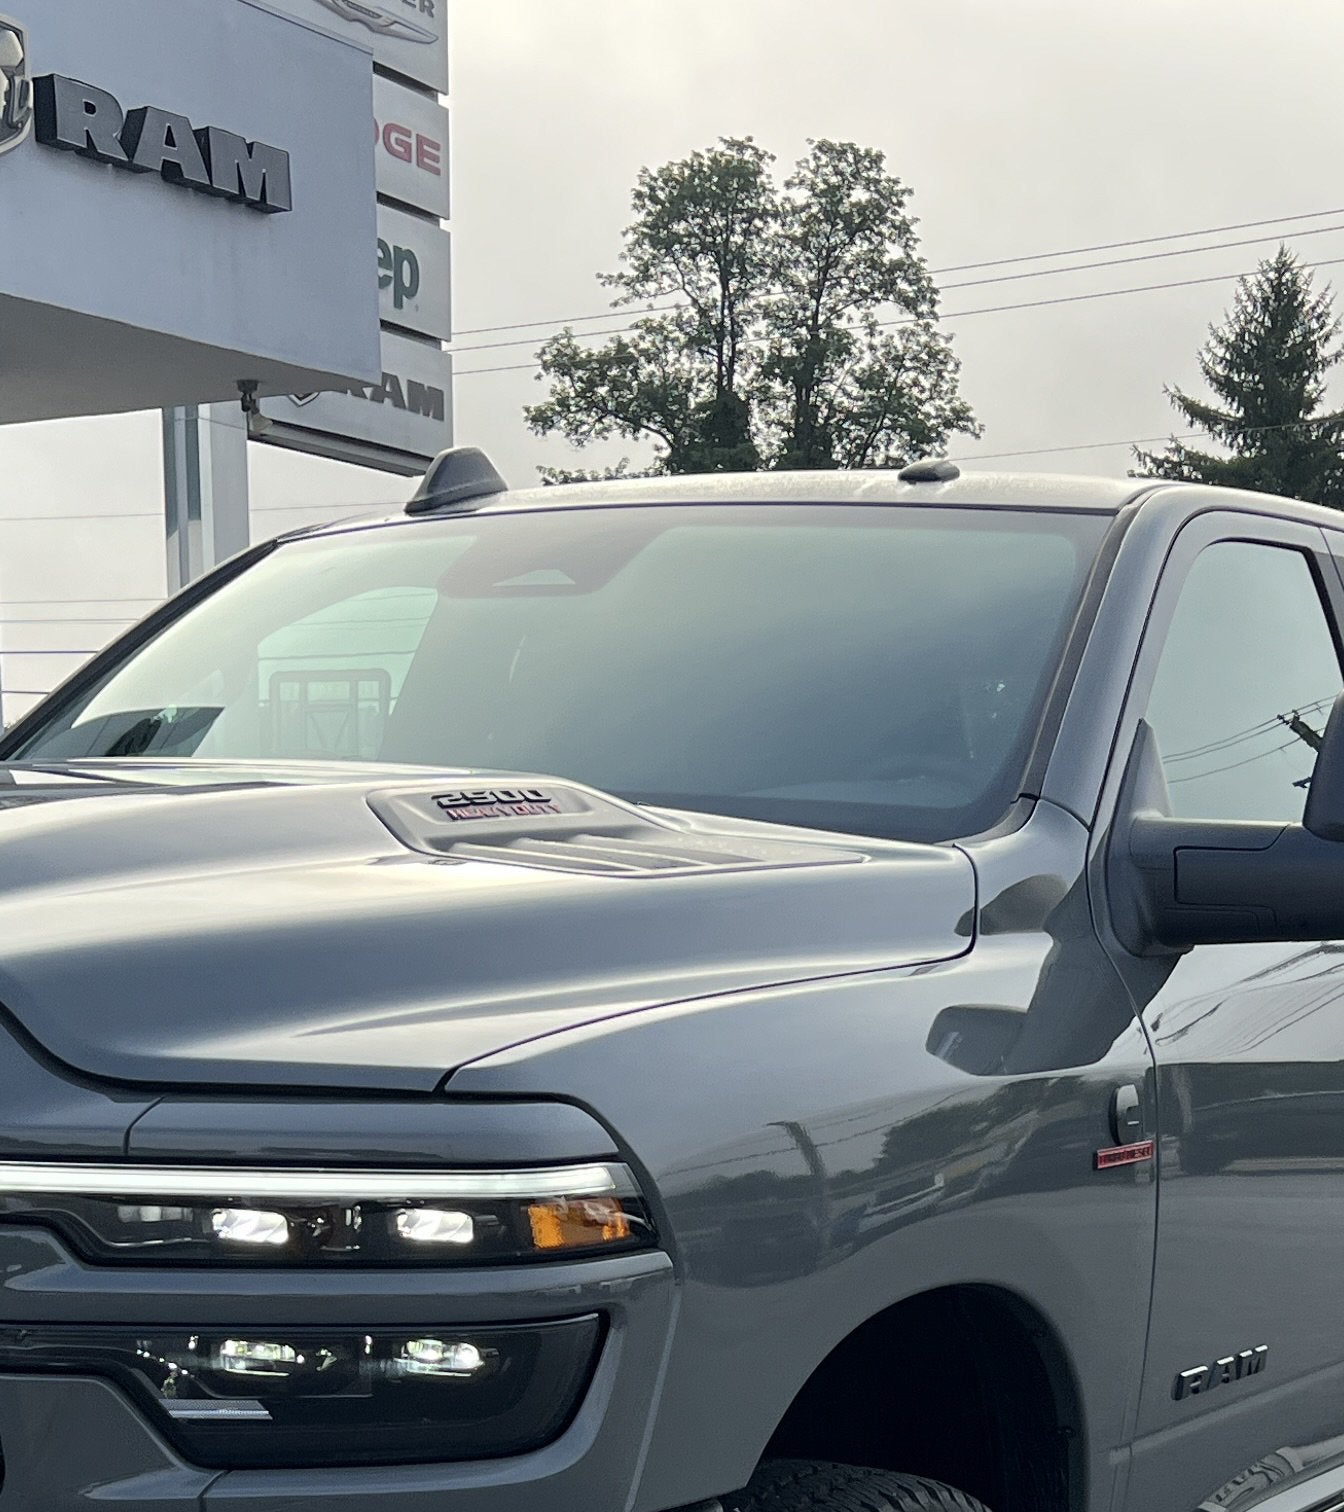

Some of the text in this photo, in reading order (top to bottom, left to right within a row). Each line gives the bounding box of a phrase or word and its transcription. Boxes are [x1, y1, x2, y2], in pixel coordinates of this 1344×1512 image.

[33, 73, 293, 214] RAM
[431, 789, 552, 809] 2500
[1170, 1344, 1269, 1401] RAM
